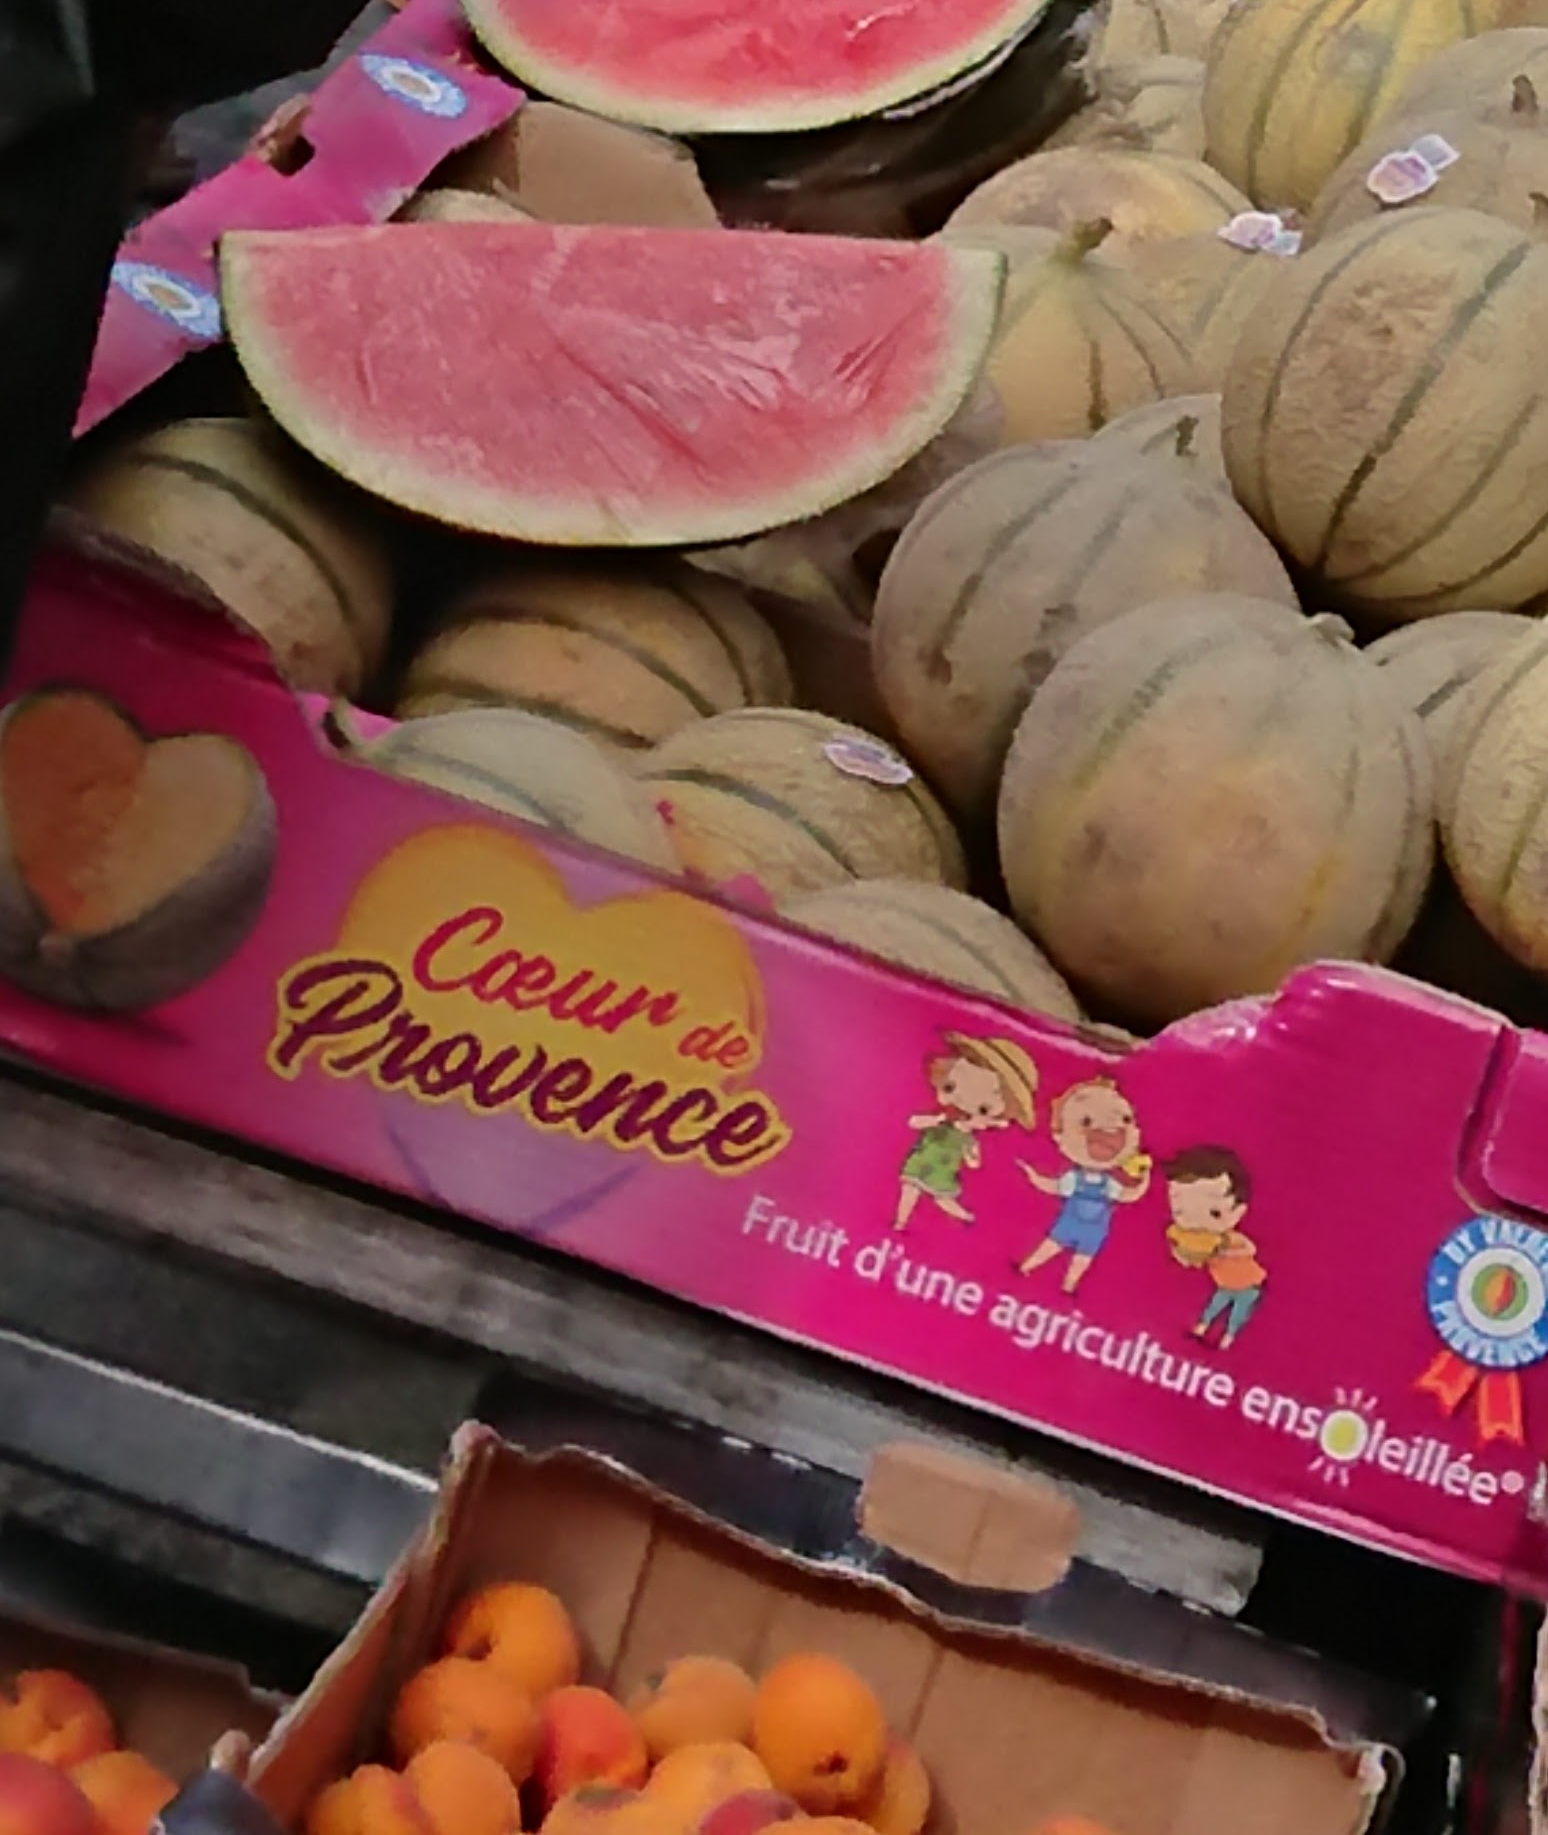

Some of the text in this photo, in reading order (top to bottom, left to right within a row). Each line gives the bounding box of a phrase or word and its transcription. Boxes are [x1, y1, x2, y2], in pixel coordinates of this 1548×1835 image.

[275, 957, 784, 1168] Provence
[412, 905, 754, 1070] Cœur de
[741, 1194, 850, 1268] Fruit
[854, 1238, 984, 1316] d'une
[989, 1293, 1235, 1408] agriculture
[1430, 1300, 1548, 1367] PROVENCE
